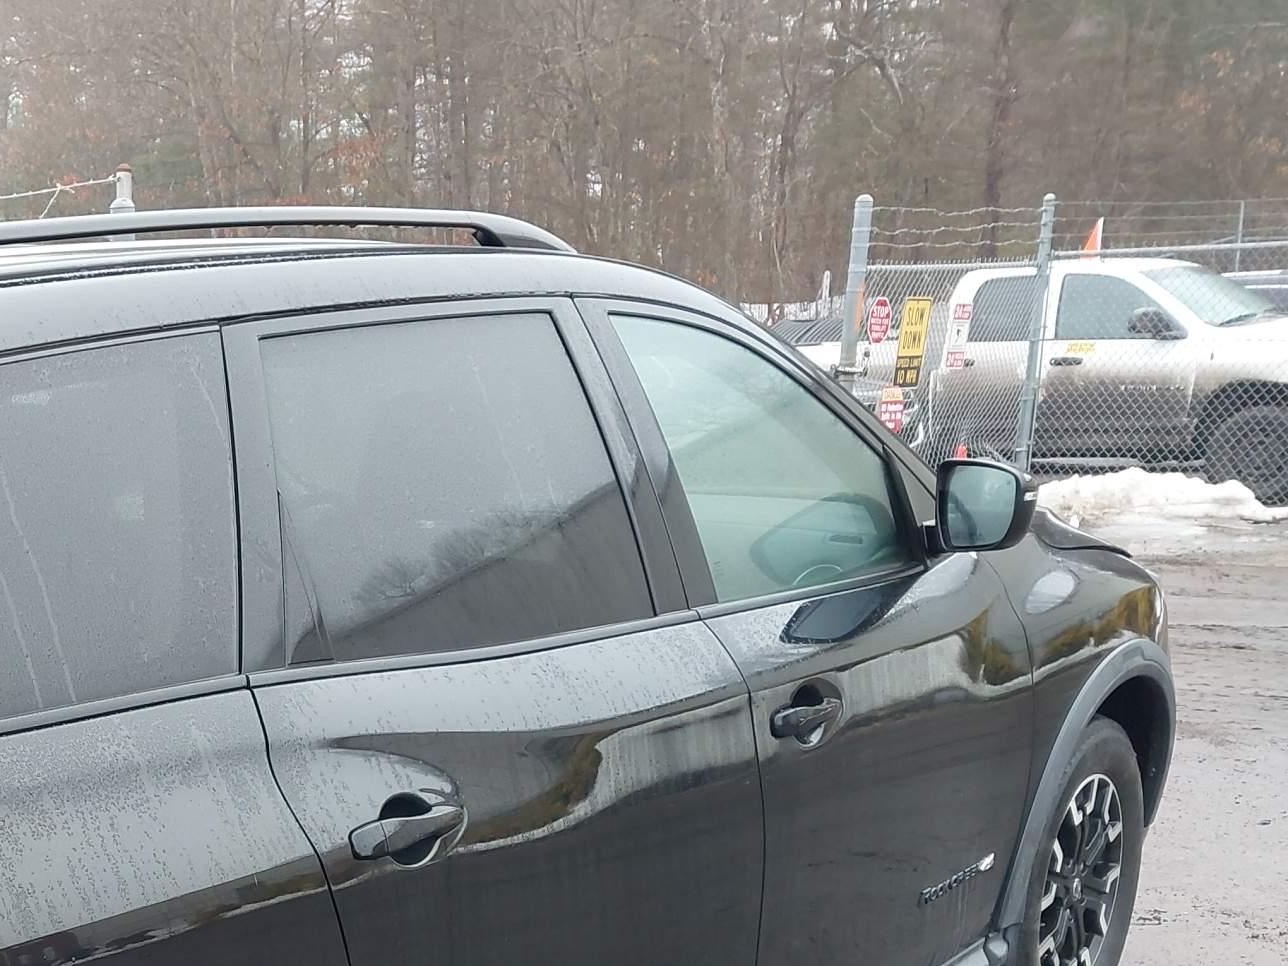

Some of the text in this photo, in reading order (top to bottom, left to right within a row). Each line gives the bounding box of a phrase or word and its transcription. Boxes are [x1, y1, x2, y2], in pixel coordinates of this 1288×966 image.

[872, 305, 889, 318] STOP
[906, 306, 926, 326] SLOW
[902, 330, 923, 350] DOWN
[897, 358, 910, 368] SPEED
[896, 368, 918, 385] 10 MPH
